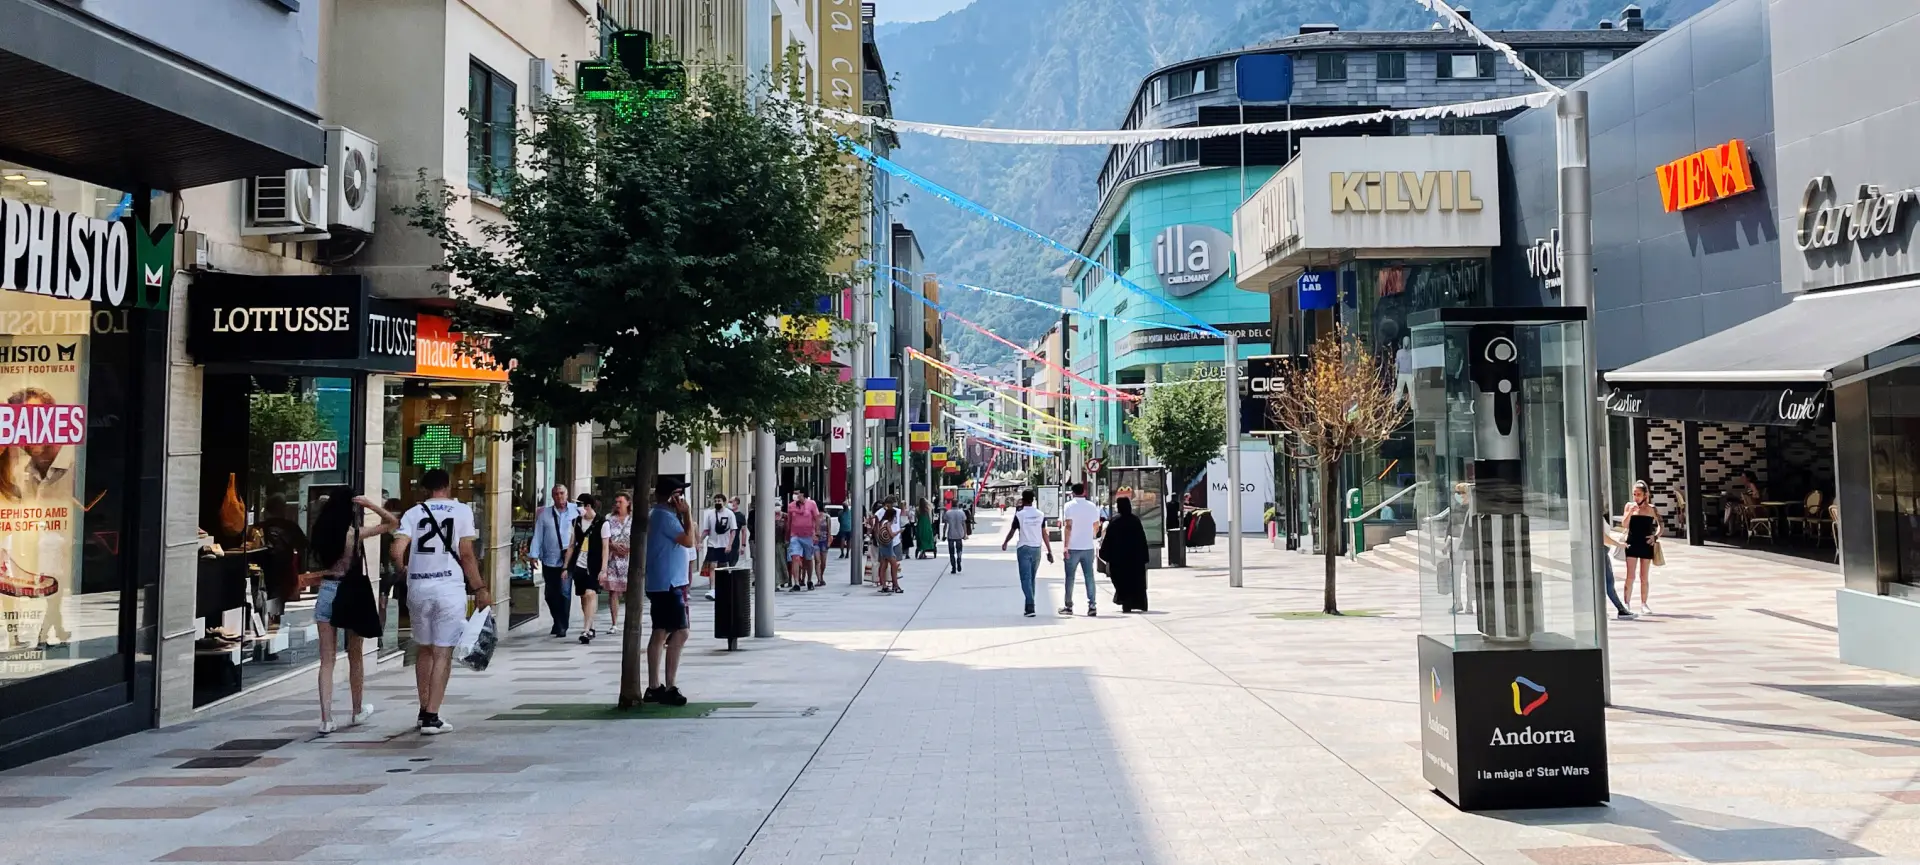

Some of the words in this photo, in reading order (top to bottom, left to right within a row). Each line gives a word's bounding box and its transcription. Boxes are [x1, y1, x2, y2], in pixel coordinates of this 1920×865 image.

[1656, 140, 1749, 213] VIENA
[1794, 177, 1914, 251] Cartier
[0, 199, 129, 306] PHISTO
[1157, 224, 1210, 274] illa
[1526, 229, 1563, 278] viole
[1302, 274, 1319, 282] AW
[1302, 283, 1322, 291] LAB
[213, 306, 350, 332] LOTTUSSE
[369, 313, 416, 356] TTUSSE
[1249, 328, 1263, 337] DEL
[0, 345, 51, 362] HISTO
[28, 364, 76, 373] FOOTWEAR
[1200, 366, 1244, 378] GUES
[0, 406, 84, 443] BAIXES
[274, 442, 337, 472] REBAIXES
[779, 455, 812, 464] Bershka
[1212, 482, 1256, 492] MAGO
[1, 508, 42, 520] EPHISTO
[45, 507, 68, 518] AMB
[414, 517, 455, 554] 21
[1490, 726, 1575, 746] Andorra
[1483, 769, 1492, 779] la
[1494, 767, 1523, 781] màgia
[1537, 766, 1559, 777] Star
[1561, 765, 1590, 776] Wars
